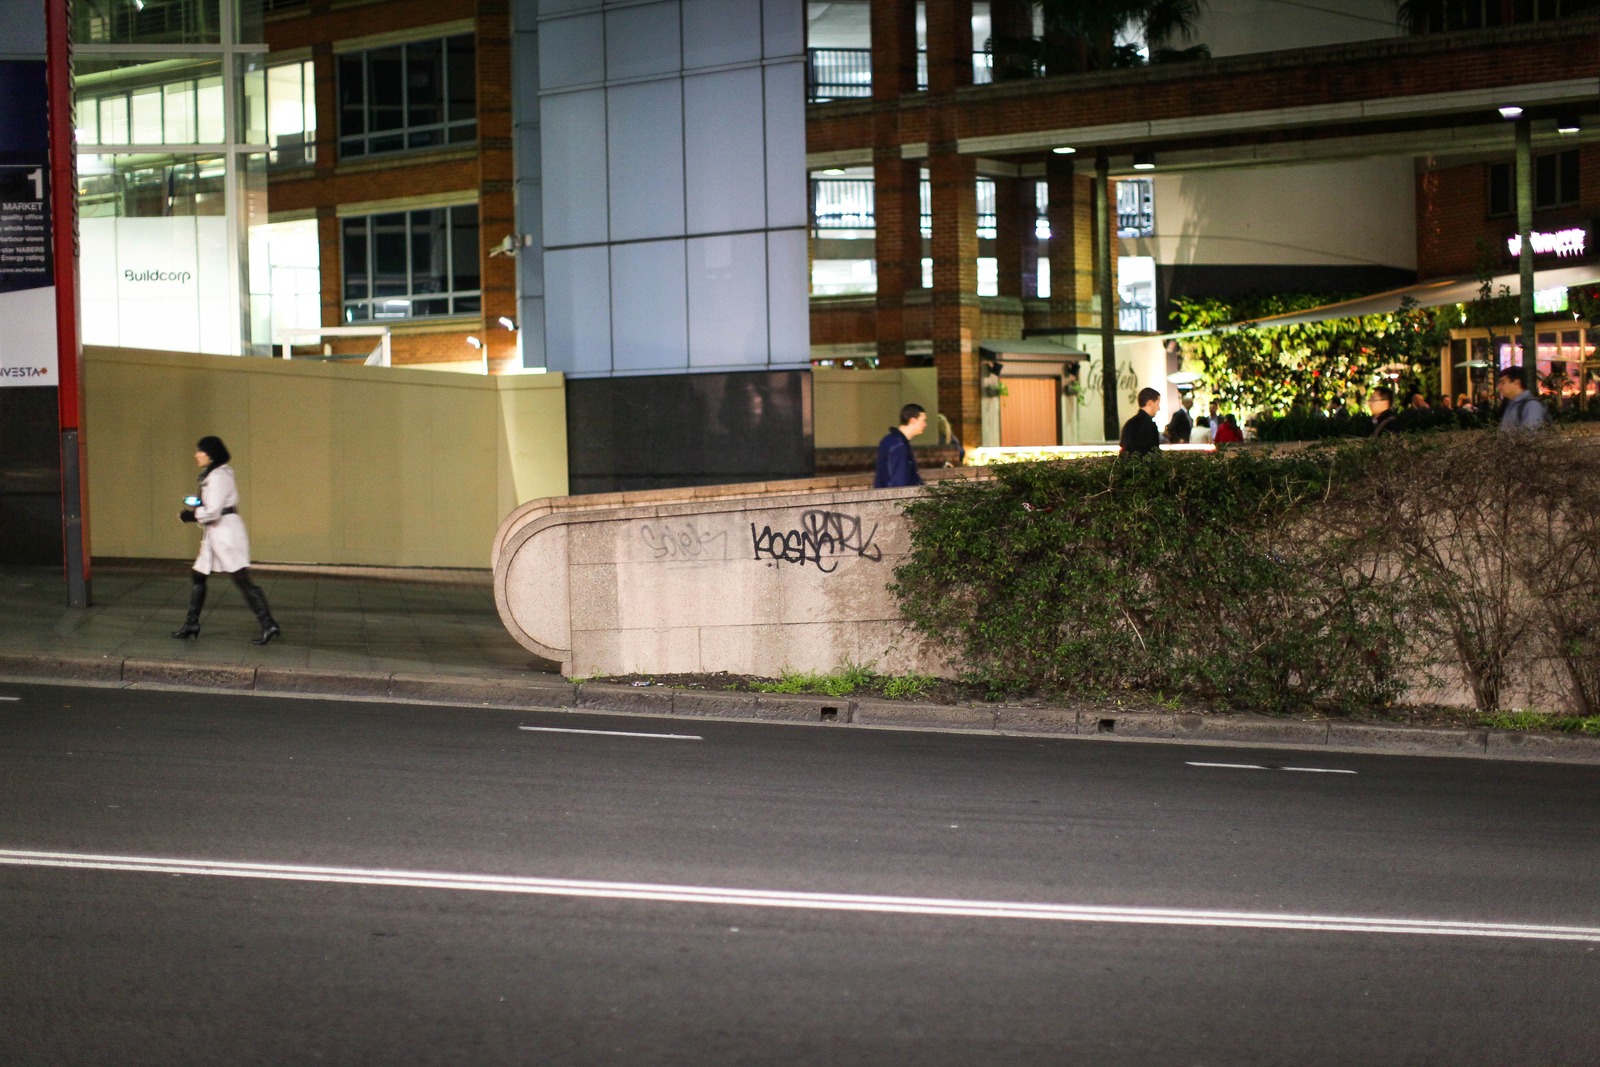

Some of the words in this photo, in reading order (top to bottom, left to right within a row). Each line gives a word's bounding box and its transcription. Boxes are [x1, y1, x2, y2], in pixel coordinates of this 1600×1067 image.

[27, 168, 43, 199] 1
[2, 202, 43, 211] MARKET
[124, 269, 191, 284] Buildcorp
